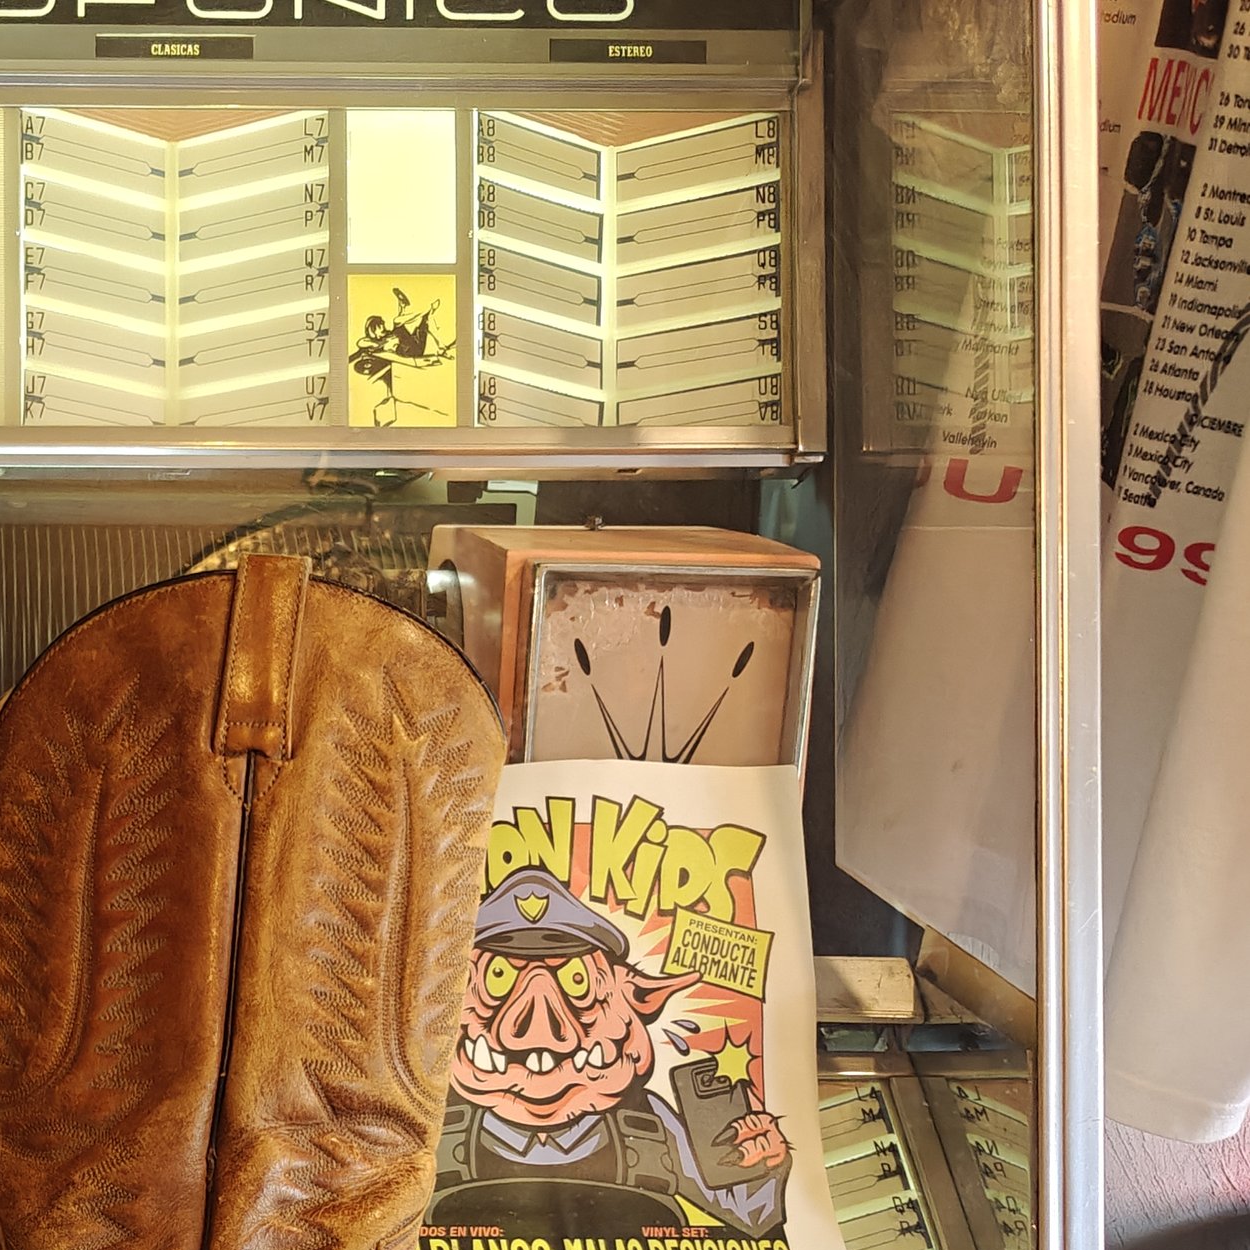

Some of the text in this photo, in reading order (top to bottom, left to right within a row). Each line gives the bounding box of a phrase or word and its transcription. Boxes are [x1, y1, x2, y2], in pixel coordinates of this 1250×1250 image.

[151, 43, 200, 56] CLASICAS
[608, 45, 653, 57] ESTEREO
[25, 116, 46, 133] A7
[304, 118, 325, 136] L7
[754, 121, 776, 139] L8
[304, 145, 325, 163] M7
[25, 182, 46, 200] C7
[754, 186, 776, 204] N8
[304, 211, 325, 228] P7
[1200, 229, 1234, 249] Tampa
[304, 249, 325, 267] Q7
[757, 250, 778, 268] Q8
[304, 313, 325, 331] S7
[1160, 361, 1200, 381] Atlanta
[304, 377, 325, 395] U7
[757, 377, 778, 396] U8
[304, 402, 325, 420] V7
[688, 918, 758, 946] PRESENTAN:
[680, 929, 757, 968] CONDUCTA
[670, 946, 758, 989] ALARMANTE
[450, 1226, 467, 1237] EN
[470, 1226, 505, 1237] VIVO:
[642, 1226, 710, 1238] VINYL SET:
